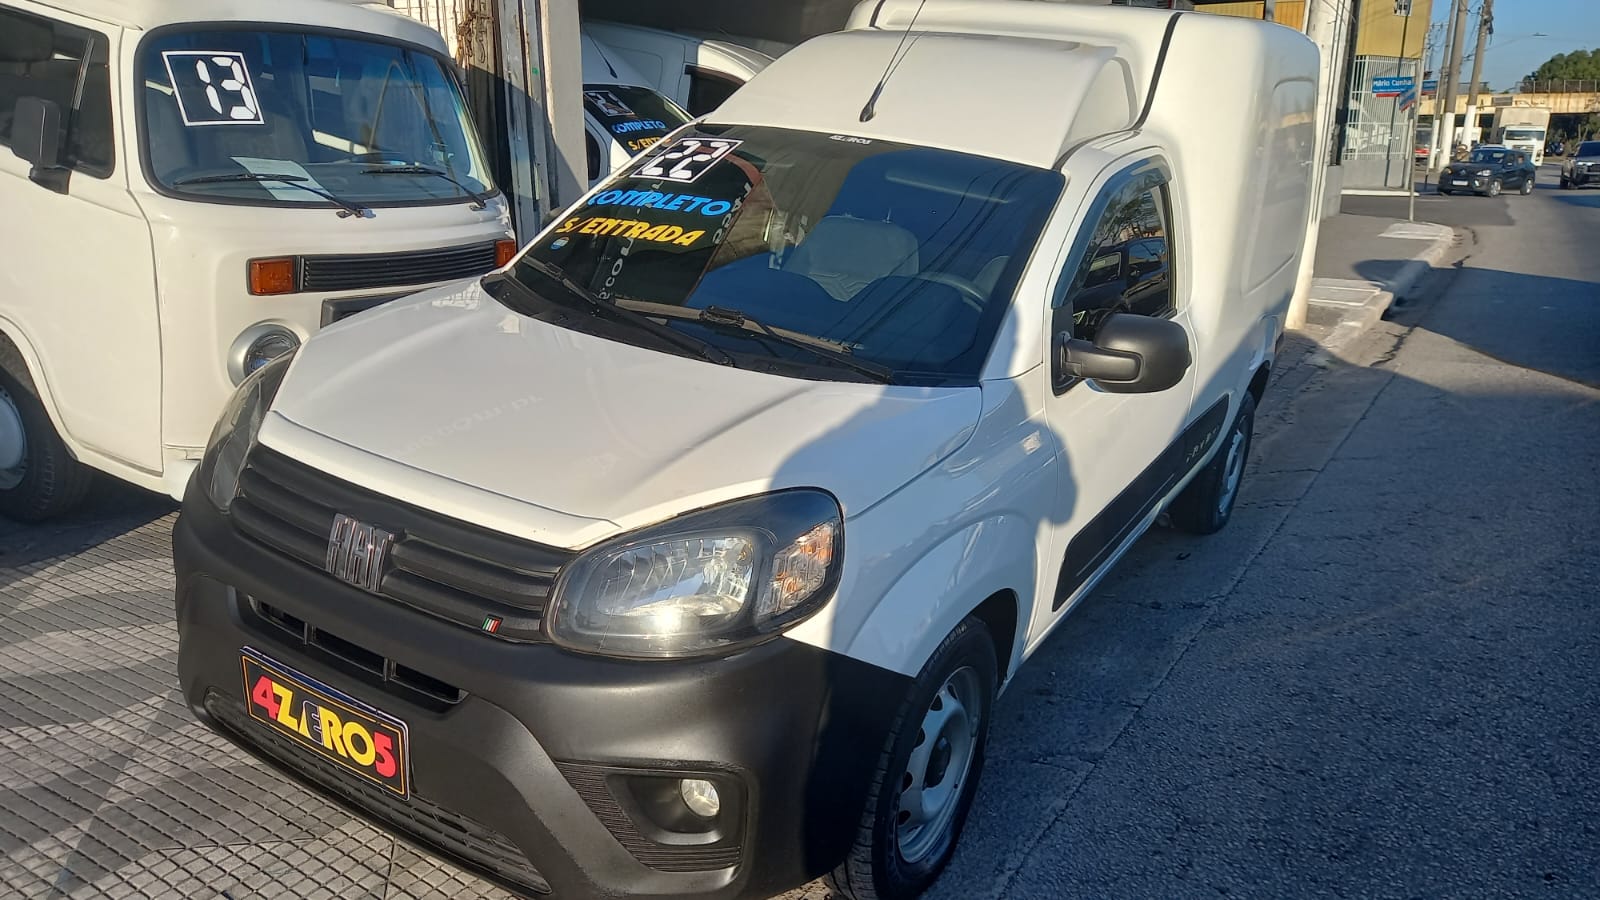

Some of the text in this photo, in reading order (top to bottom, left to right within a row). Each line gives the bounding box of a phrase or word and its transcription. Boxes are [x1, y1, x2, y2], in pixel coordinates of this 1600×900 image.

[196, 57, 257, 120] 13
[611, 120, 668, 134] COMPLETO
[642, 140, 731, 179] 22
[587, 189, 733, 216] COMPLETO
[555, 217, 706, 247] S/ENTRADA
[326, 513, 395, 592] FIAT
